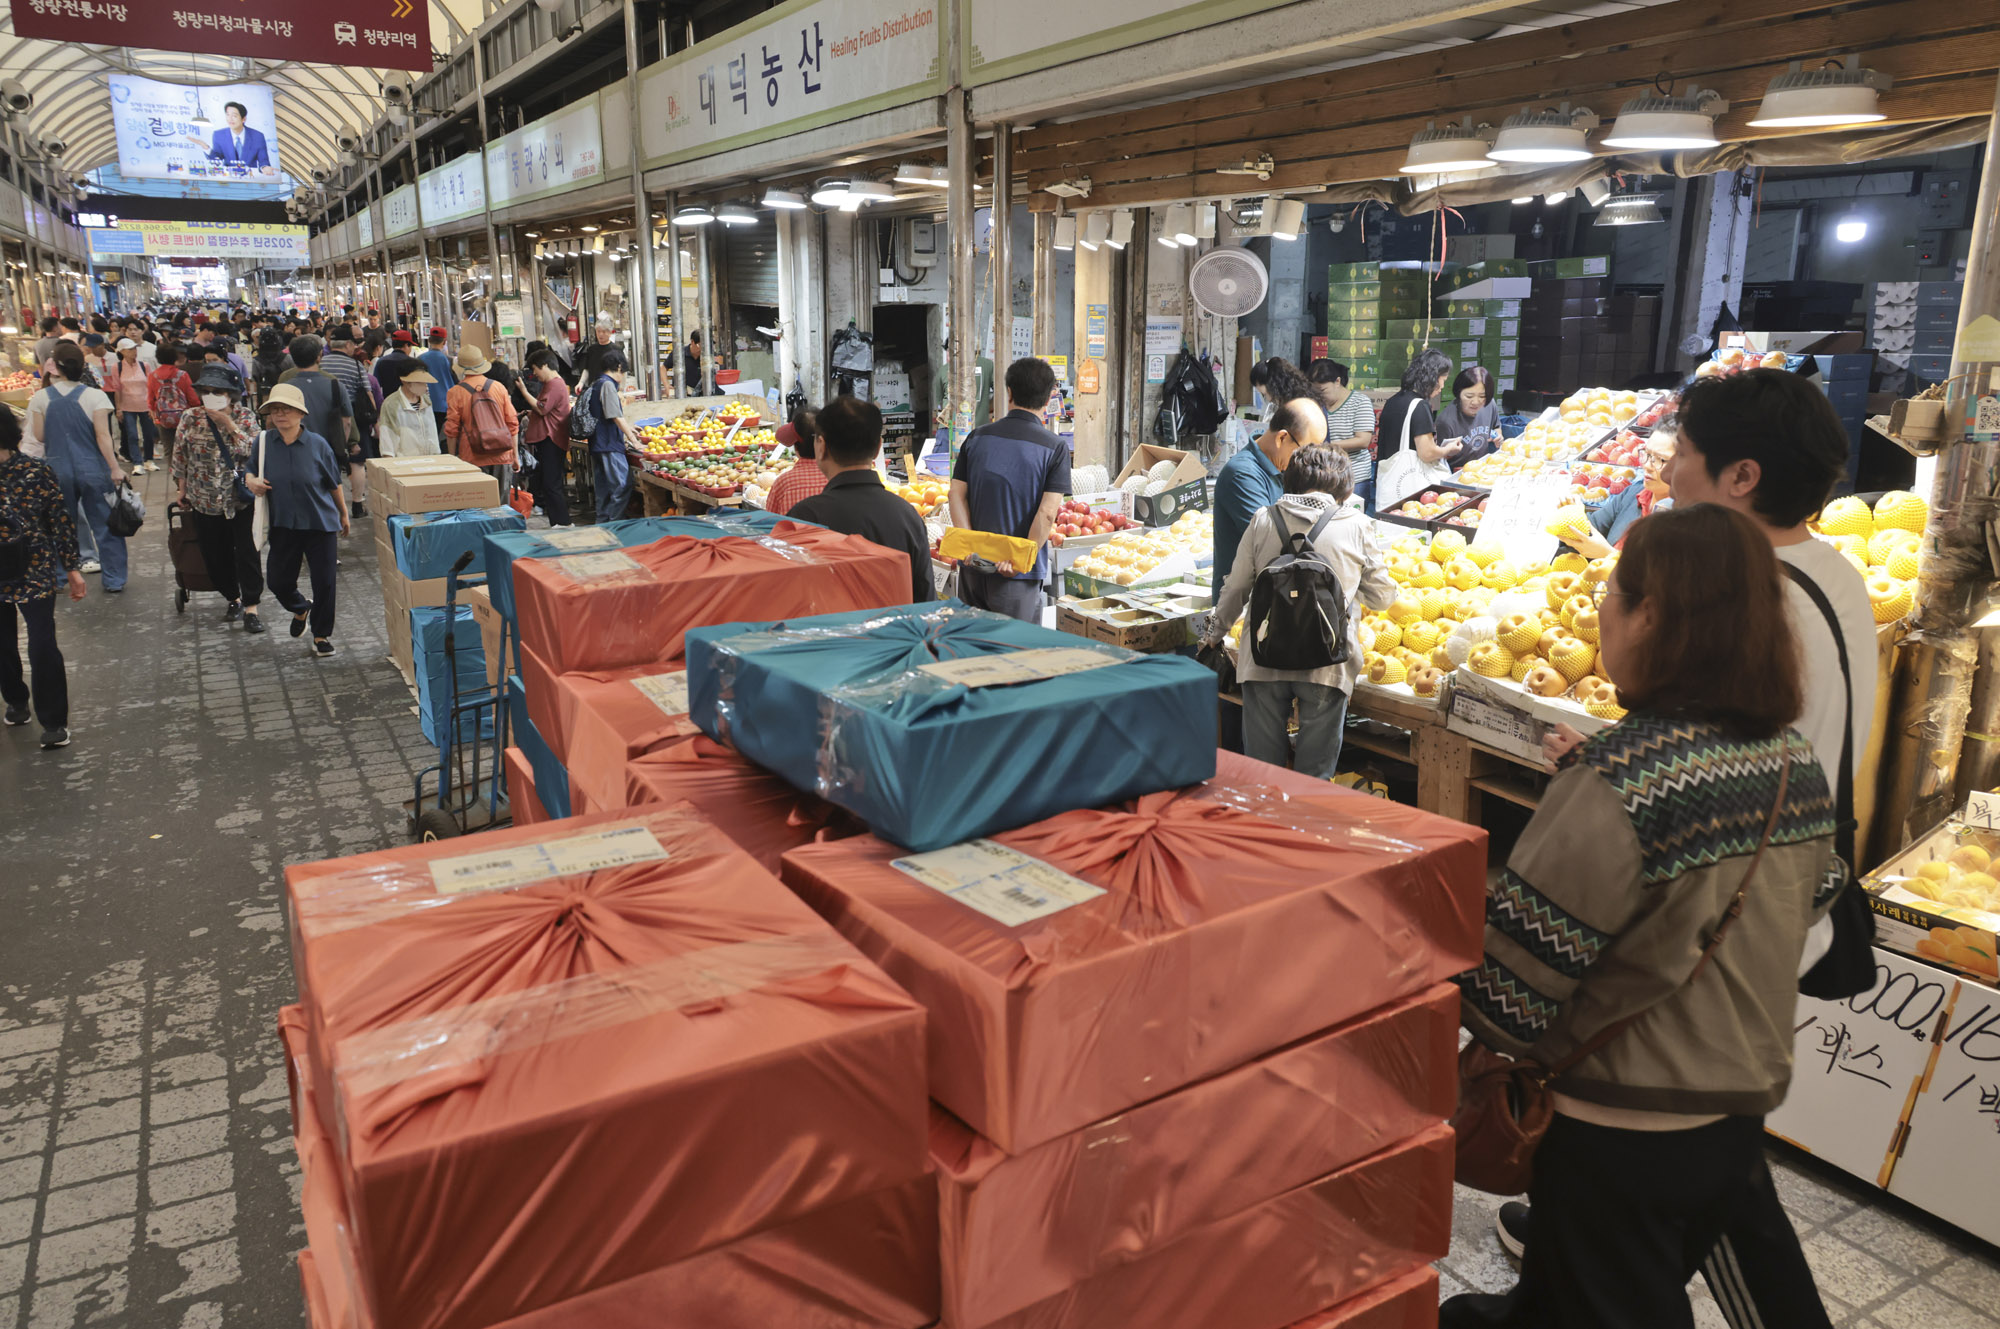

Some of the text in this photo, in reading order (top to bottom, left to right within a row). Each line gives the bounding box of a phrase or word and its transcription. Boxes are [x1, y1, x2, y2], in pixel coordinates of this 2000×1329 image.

[172, 10, 293, 37] 청량리청과물시장
[364, 28, 417, 48] 청량리역
[830, 8, 932, 60] Healing Fruits Distribution
[698, 22, 824, 126] 대덕농산
